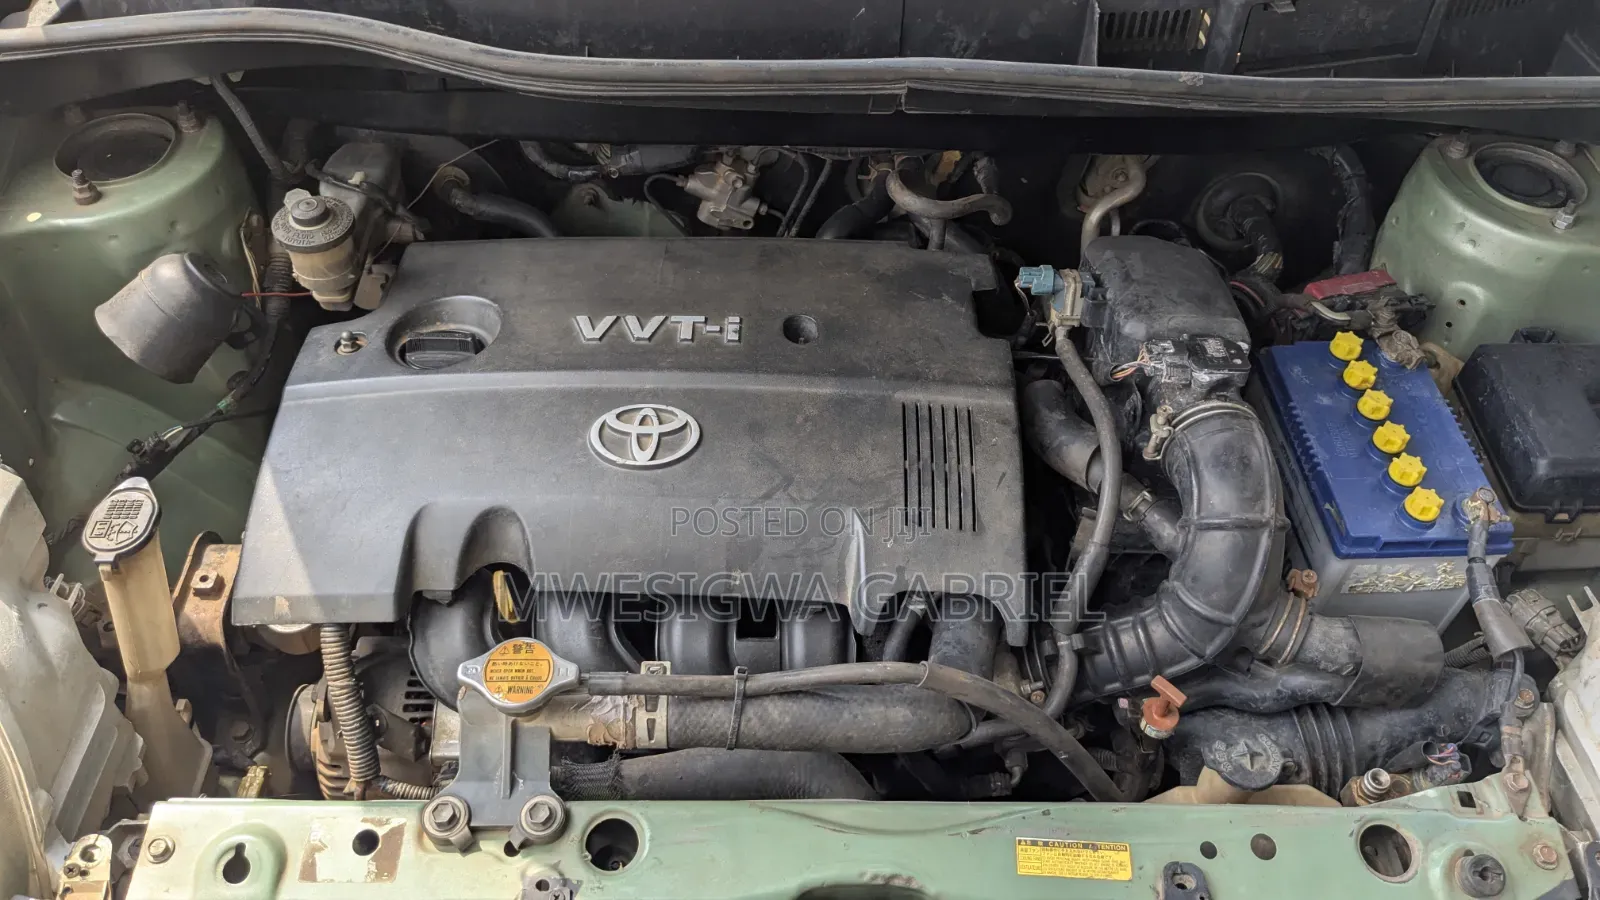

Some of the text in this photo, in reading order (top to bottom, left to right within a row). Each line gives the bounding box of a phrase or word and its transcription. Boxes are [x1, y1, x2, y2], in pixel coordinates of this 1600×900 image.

[573, 315, 742, 343] VVT-i
[507, 685, 534, 695] WARNING
[1048, 841, 1083, 849] CAUTION
[1088, 843, 1127, 851] ATENTION
